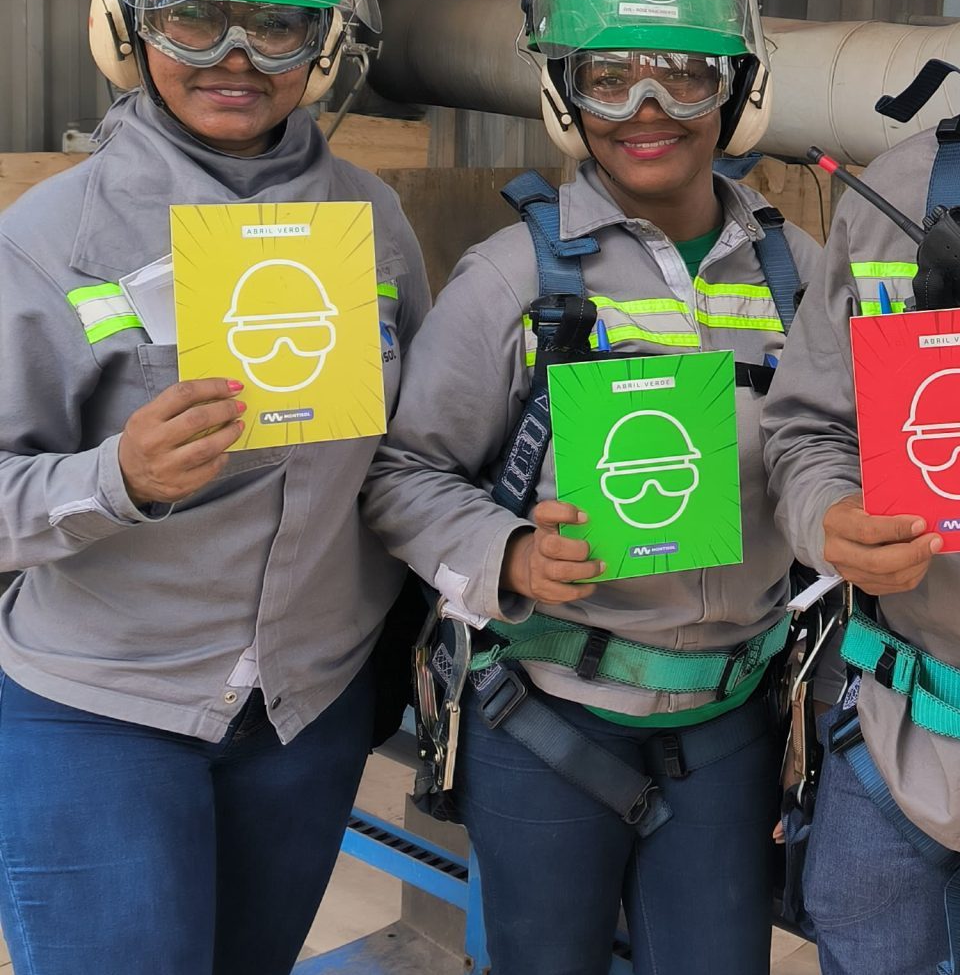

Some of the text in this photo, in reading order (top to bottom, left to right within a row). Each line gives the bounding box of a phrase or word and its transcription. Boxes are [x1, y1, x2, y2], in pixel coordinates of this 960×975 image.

[924, 337, 950, 345] ABRIL
[616, 379, 670, 390] ABRIL VERDE
